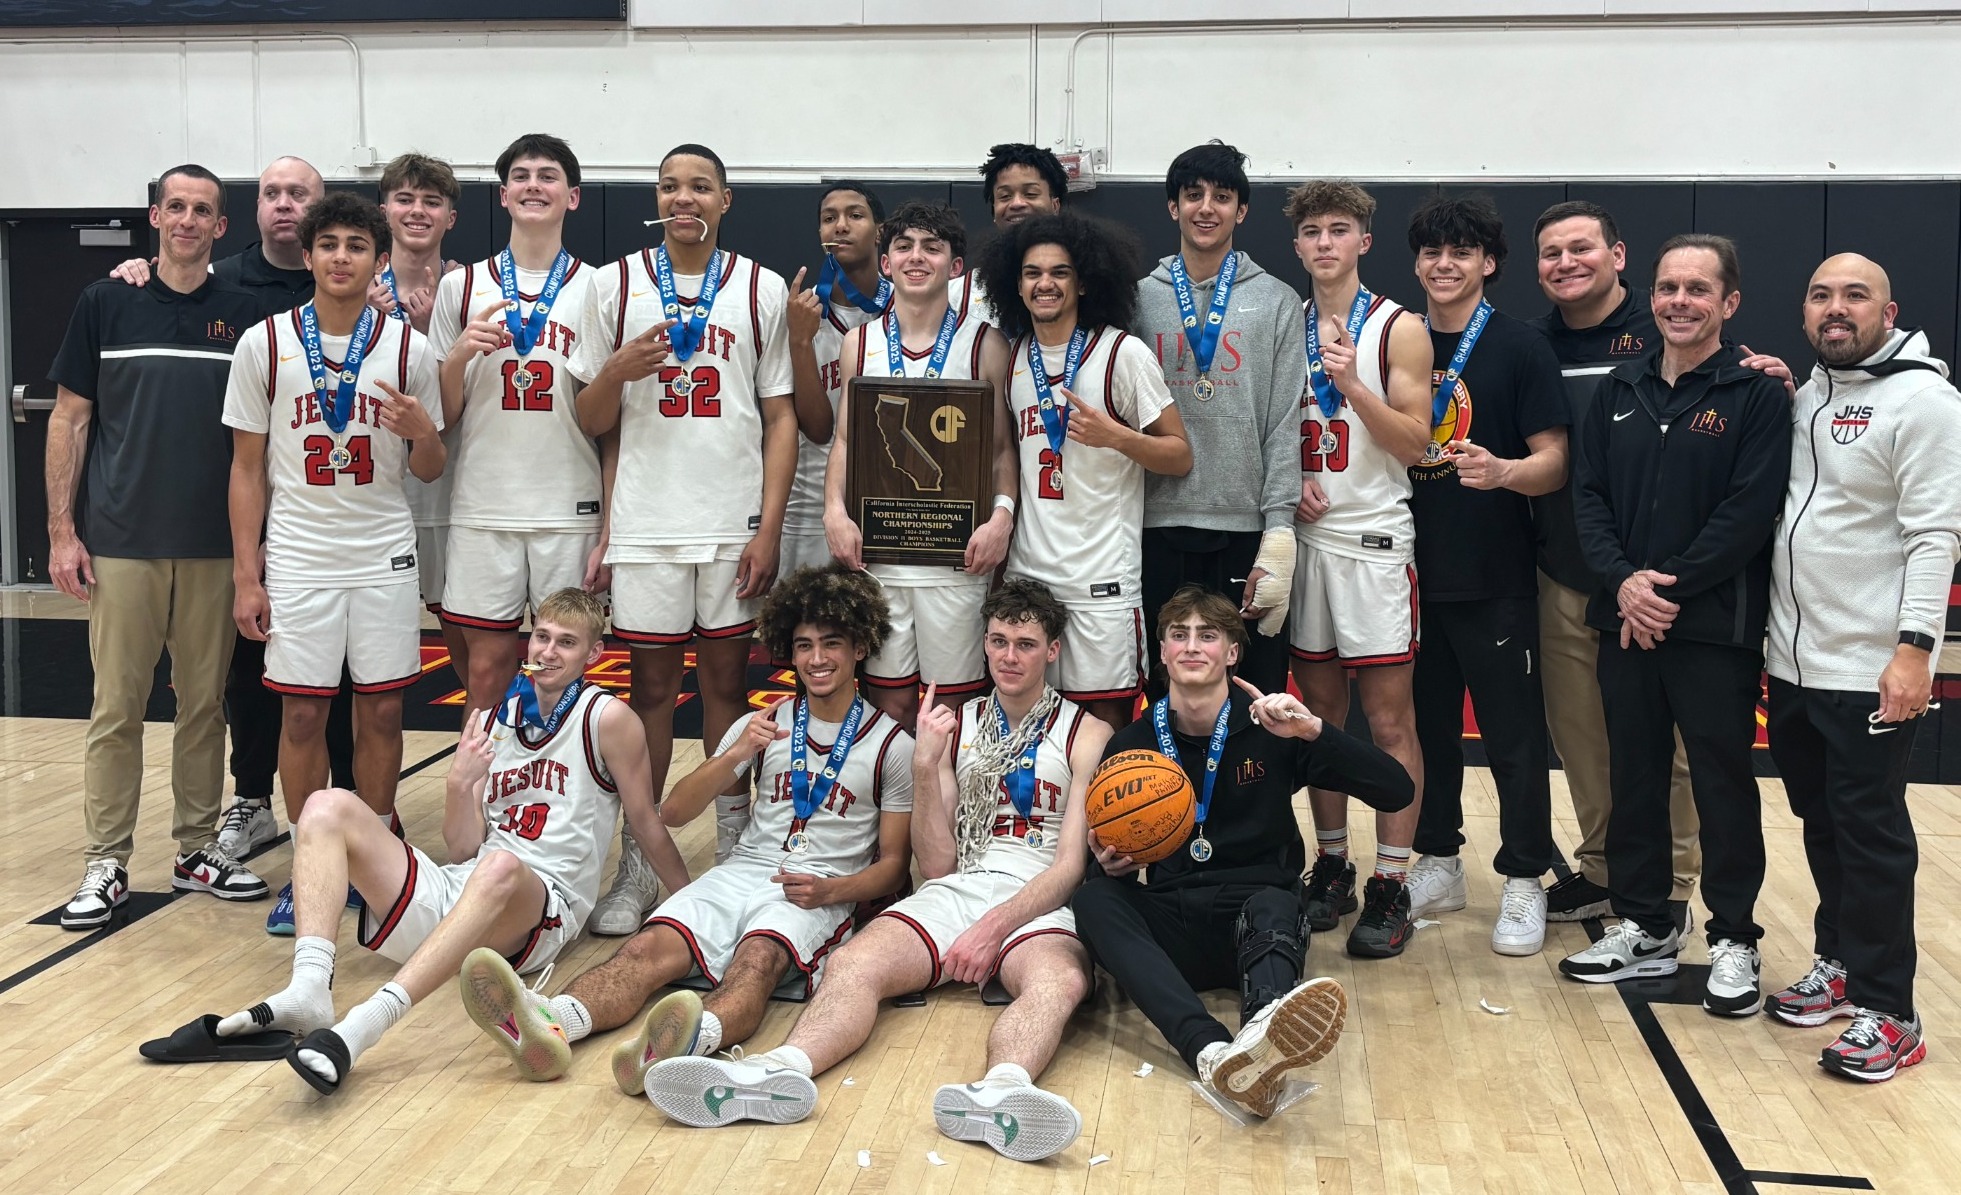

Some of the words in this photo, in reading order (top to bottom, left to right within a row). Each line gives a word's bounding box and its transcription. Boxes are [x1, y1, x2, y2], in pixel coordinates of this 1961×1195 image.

[501, 249, 516, 297] 2024-2025
[544, 253, 568, 299] CHAMPIONSHIPS
[658, 249, 674, 298] 2024-2025
[702, 249, 721, 302] CHAMPIONSHIPS
[1172, 258, 1193, 312] 2024-2025
[1214, 254, 1237, 307] CHAMPIONSHIPS
[305, 313, 324, 372] 2024-2025
[348, 307, 373, 364] CHAMPIONSHIPS
[933, 310, 957, 363] CHAMPIONSHIPS
[1064, 328, 1085, 388] CHAMPIONSHIPS
[1454, 307, 1488, 363] CHAMPIONSHIPS
[1608, 333, 1644, 354] JHS
[500, 359, 554, 411] 12
[658, 365, 721, 418] 32
[929, 404, 967, 443] CIF
[1688, 409, 1728, 432] JHS
[1834, 405, 1874, 420] JHS
[304, 434, 374, 486] 24
[1301, 419, 1350, 473] 20
[1038, 447, 1065, 501] 2
[865, 499, 895, 507] California
[896, 500, 939, 509] Interscholastic
[940, 502, 972, 510] Federation
[872, 511, 918, 520] NORTHERN
[920, 512, 964, 522] REGIONAL
[882, 520, 953, 530] CHAMPIONSHIPS
[832, 705, 862, 762] CHAMPIONSHIPS
[487, 758, 569, 804] JESUIT
[1103, 777, 1143, 808] EVO
[1142, 774, 1157, 783] NXT
[1236, 760, 1265, 785] JHS
[497, 802, 551, 842] 10
